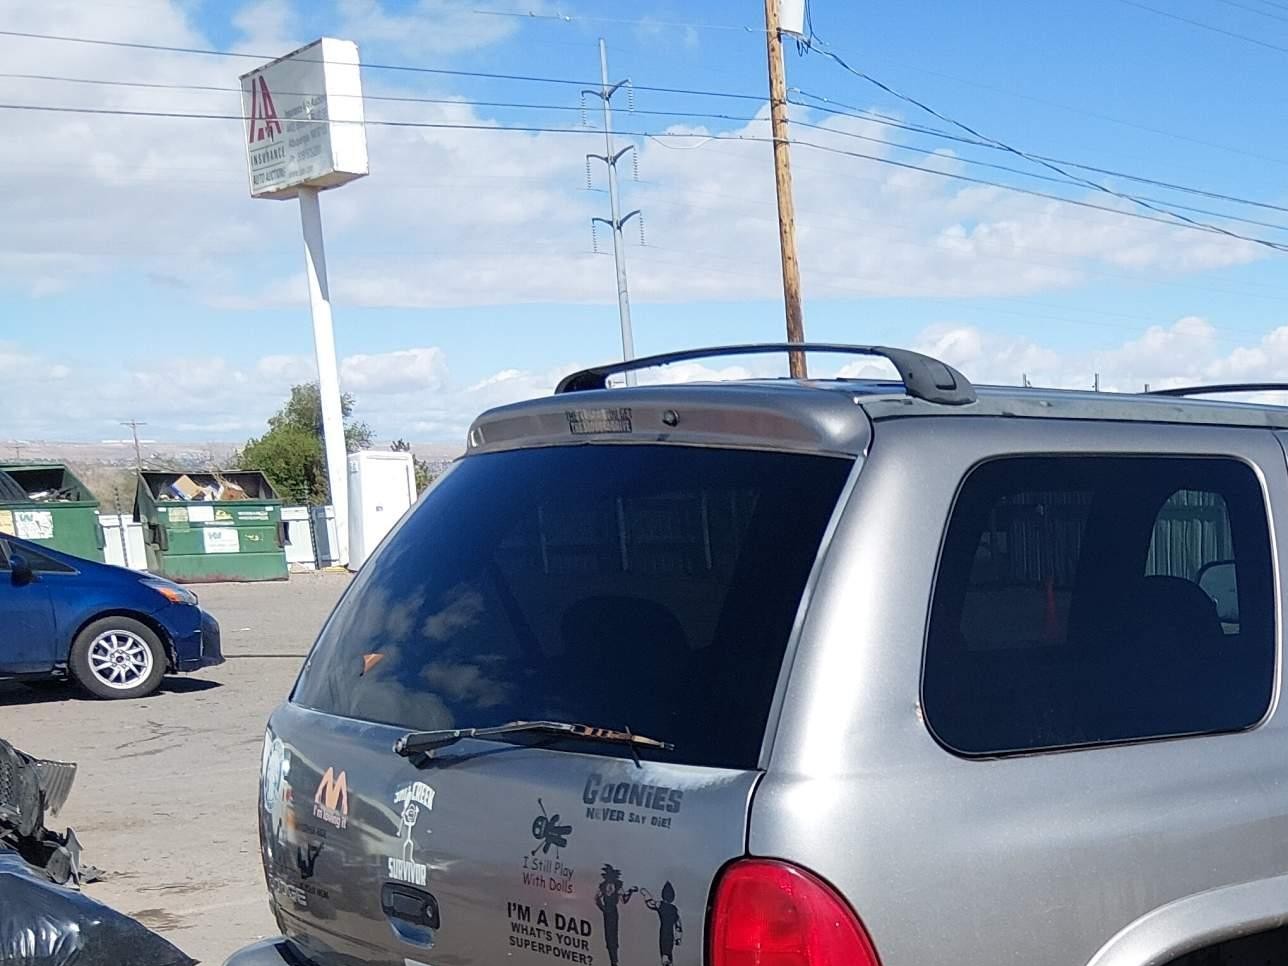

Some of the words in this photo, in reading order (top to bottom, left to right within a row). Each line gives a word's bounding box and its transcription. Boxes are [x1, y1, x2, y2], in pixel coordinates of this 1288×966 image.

[250, 145, 285, 168] INSURANCE
[412, 781, 435, 810] CREEK
[586, 807, 625, 822] NEVER
[628, 812, 646, 825] SAY
[388, 857, 427, 886] SURVIVOR
[522, 856, 529, 869] I
[531, 858, 552, 874] Still
[554, 862, 575, 880] Play
[523, 872, 546, 889] With
[549, 877, 573, 894] Dolls
[507, 902, 531, 923] I'M
[537, 910, 549, 927] A
[555, 913, 592, 937] DAD
[508, 935, 594, 966] SUPERPOWER?
[511, 922, 553, 941] WHAT'S
[556, 933, 590, 952] YOUR
